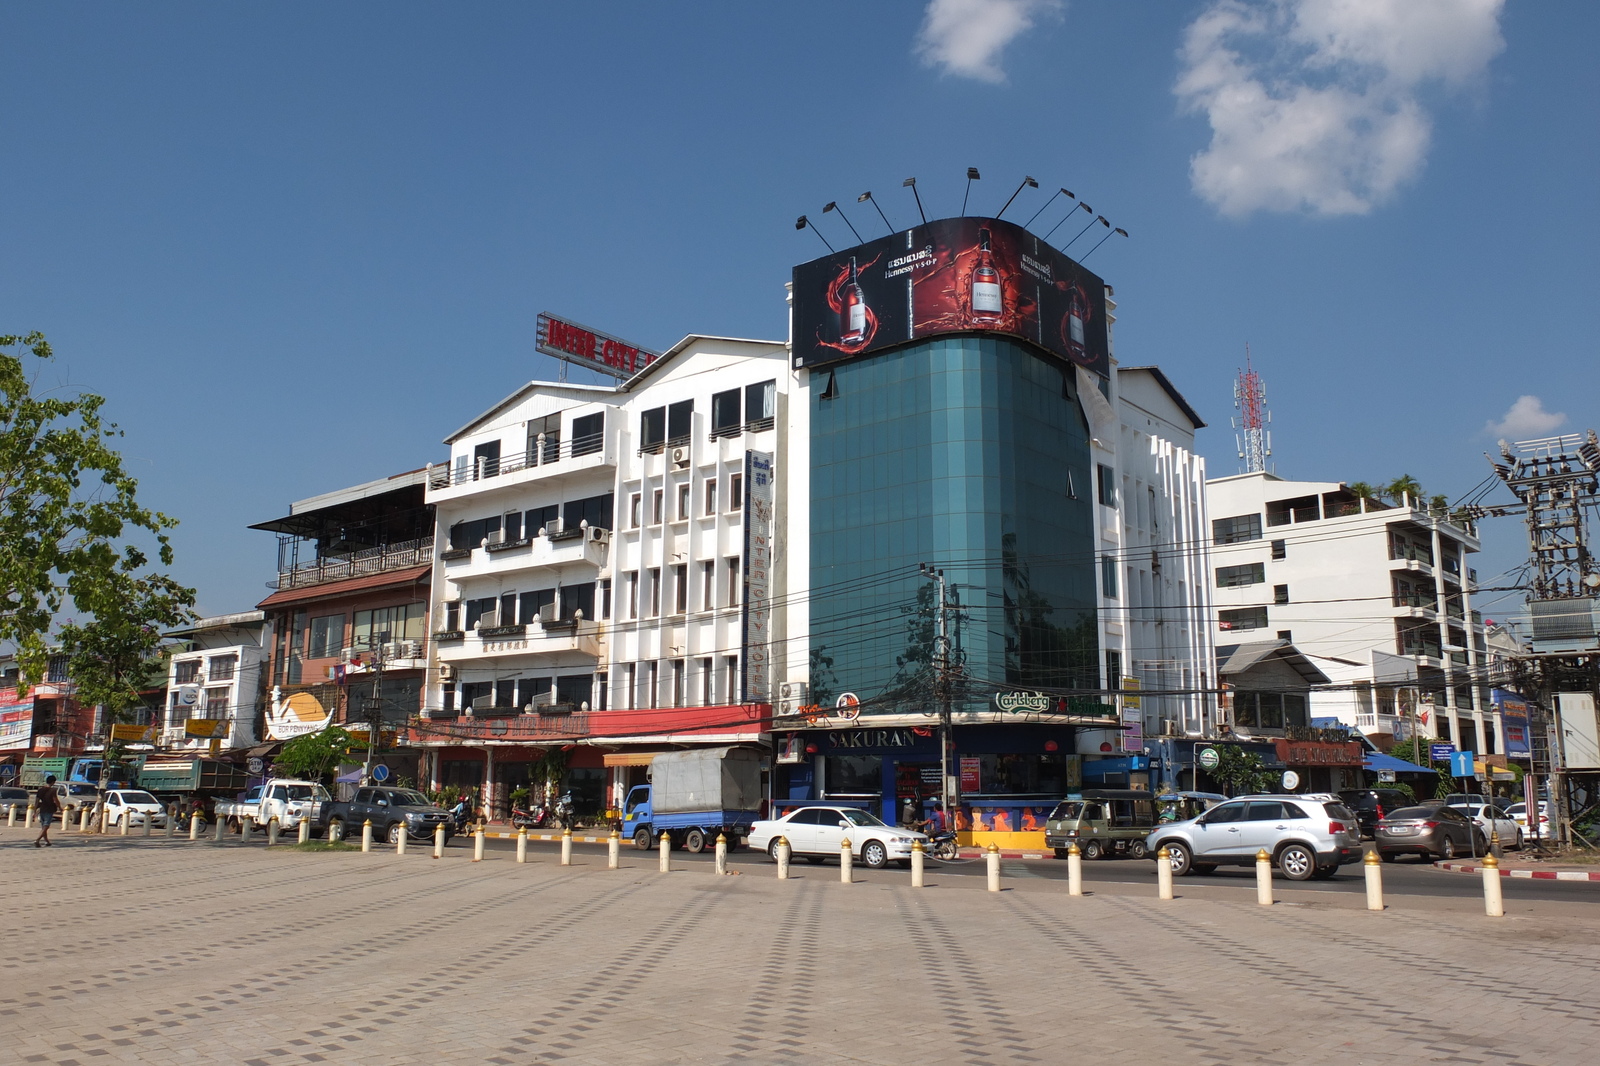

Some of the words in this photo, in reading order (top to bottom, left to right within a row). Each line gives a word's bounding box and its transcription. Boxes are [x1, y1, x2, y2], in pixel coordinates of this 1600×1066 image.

[885, 264, 914, 279] Hennessy
[546, 318, 597, 360] INTER
[602, 339, 640, 372] CITY
[753, 589, 765, 631] CITY
[996, 691, 1049, 714] Carlsberg
[828, 730, 915, 748] SAKURAN
